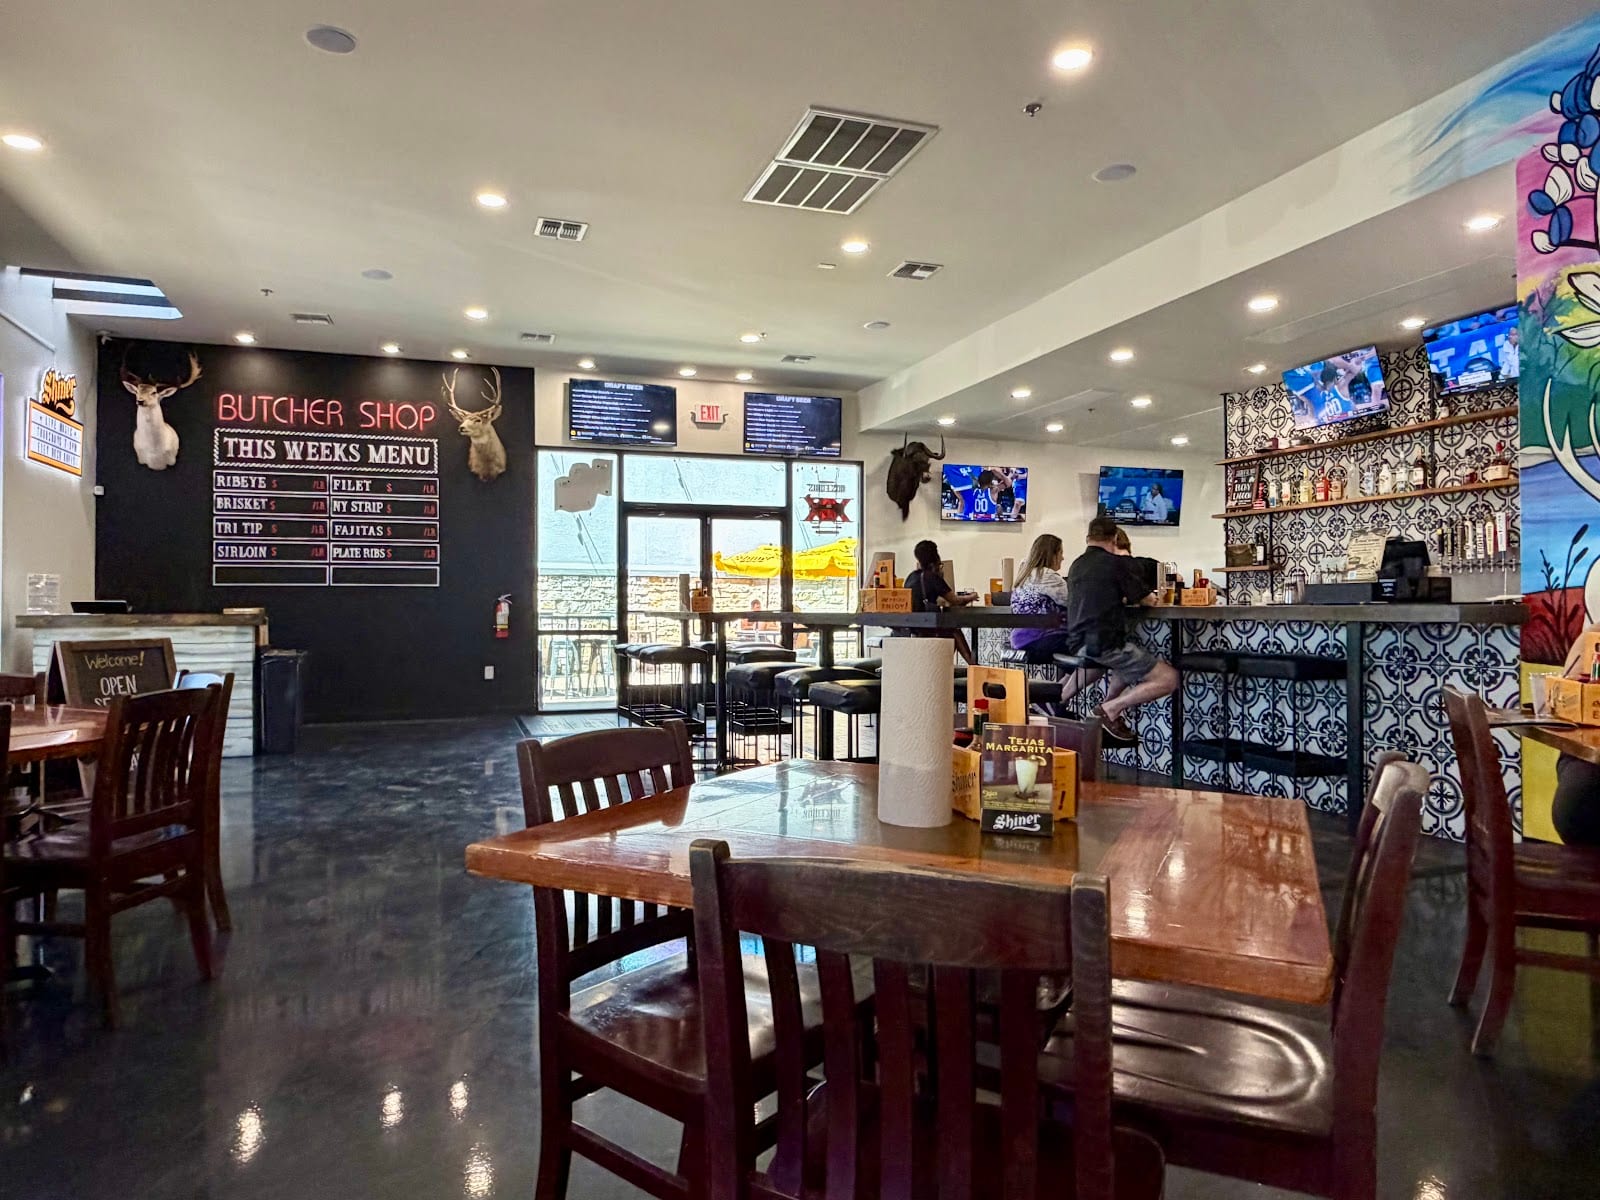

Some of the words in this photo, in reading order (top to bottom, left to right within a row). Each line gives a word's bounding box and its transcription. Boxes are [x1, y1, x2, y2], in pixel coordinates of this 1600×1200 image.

[42, 369, 77, 418] Shiner
[218, 393, 344, 427] BUTCHER
[359, 402, 435, 431] SHOP
[701, 405, 719, 421] EXIT
[224, 437, 276, 460] THIS
[284, 441, 361, 463] WEEKS
[368, 444, 430, 466] MENU
[216, 475, 267, 489] RIBEYE
[333, 480, 372, 492] FILET
[216, 497, 268, 510] BRISKET
[333, 501, 348, 512] NY
[350, 502, 384, 513] STRIP
[974, 499, 988, 513] 00
[215, 522, 238, 534] TRI
[242, 522, 263, 534] TIP
[334, 525, 384, 537] FAJITAS
[217, 545, 267, 558] SIRLOIN
[332, 547, 362, 559] PLATE
[363, 548, 386, 559] RIBS
[84, 651, 145, 670] Welcome!
[100, 674, 137, 696] OPEN
[985, 742, 1053, 754] MARGARITA
[1007, 736, 1045, 747] TEJAS
[993, 814, 1042, 832] Shiner
